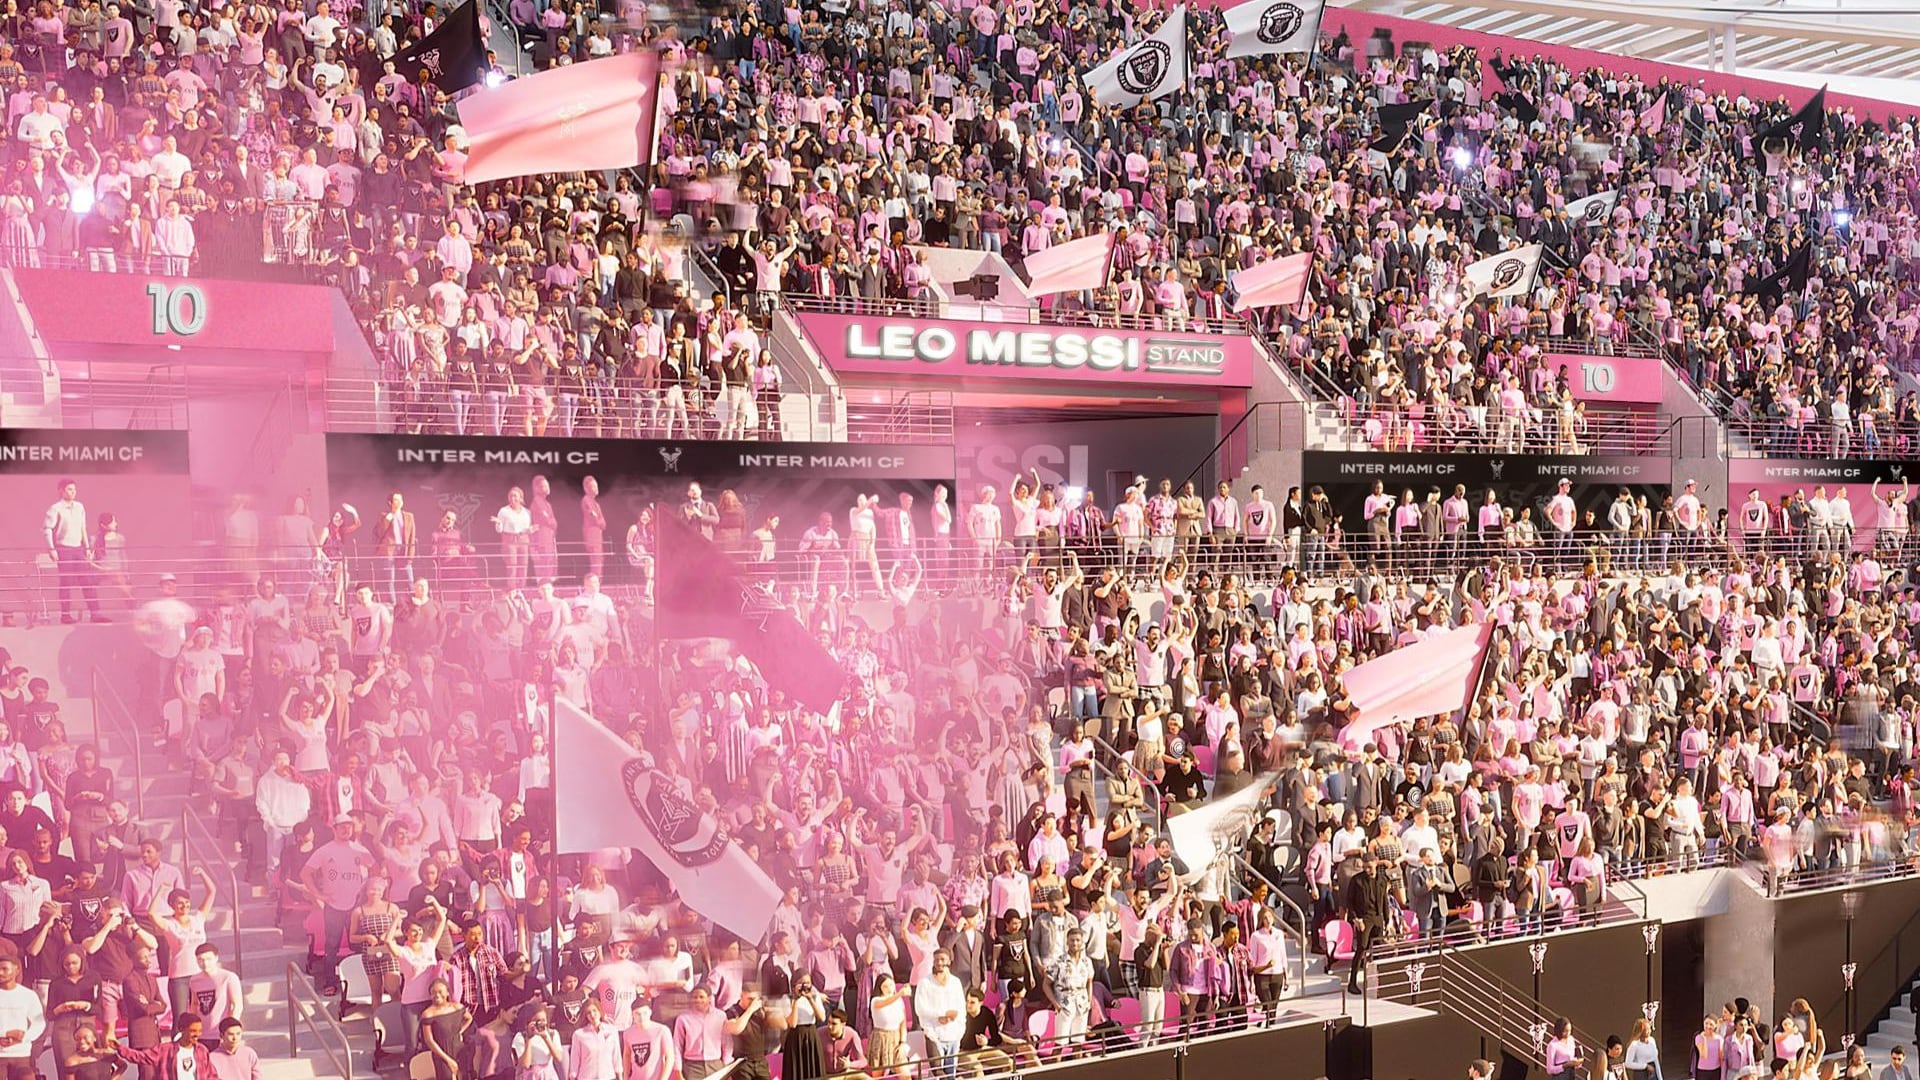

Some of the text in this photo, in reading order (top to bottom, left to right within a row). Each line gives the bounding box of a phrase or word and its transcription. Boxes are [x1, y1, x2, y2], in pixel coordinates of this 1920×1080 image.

[147, 284, 206, 335] 10
[847, 324, 1225, 369] LEO MESSI STAND
[1581, 363, 1614, 393] 10
[59, 446, 113, 461] MIAMI
[118, 446, 143, 461] CF
[398, 449, 599, 464] INTER MIAMI CF
[739, 454, 905, 469] INTER MIAMI CF
[1341, 463, 1455, 474] INTER MIAMI CF
[956, 444, 1089, 504] ESSI
[1537, 465, 1640, 475] INTER MIAMI CF
[1803, 468, 1840, 477] MIAMI
[1844, 468, 1861, 477] CF
